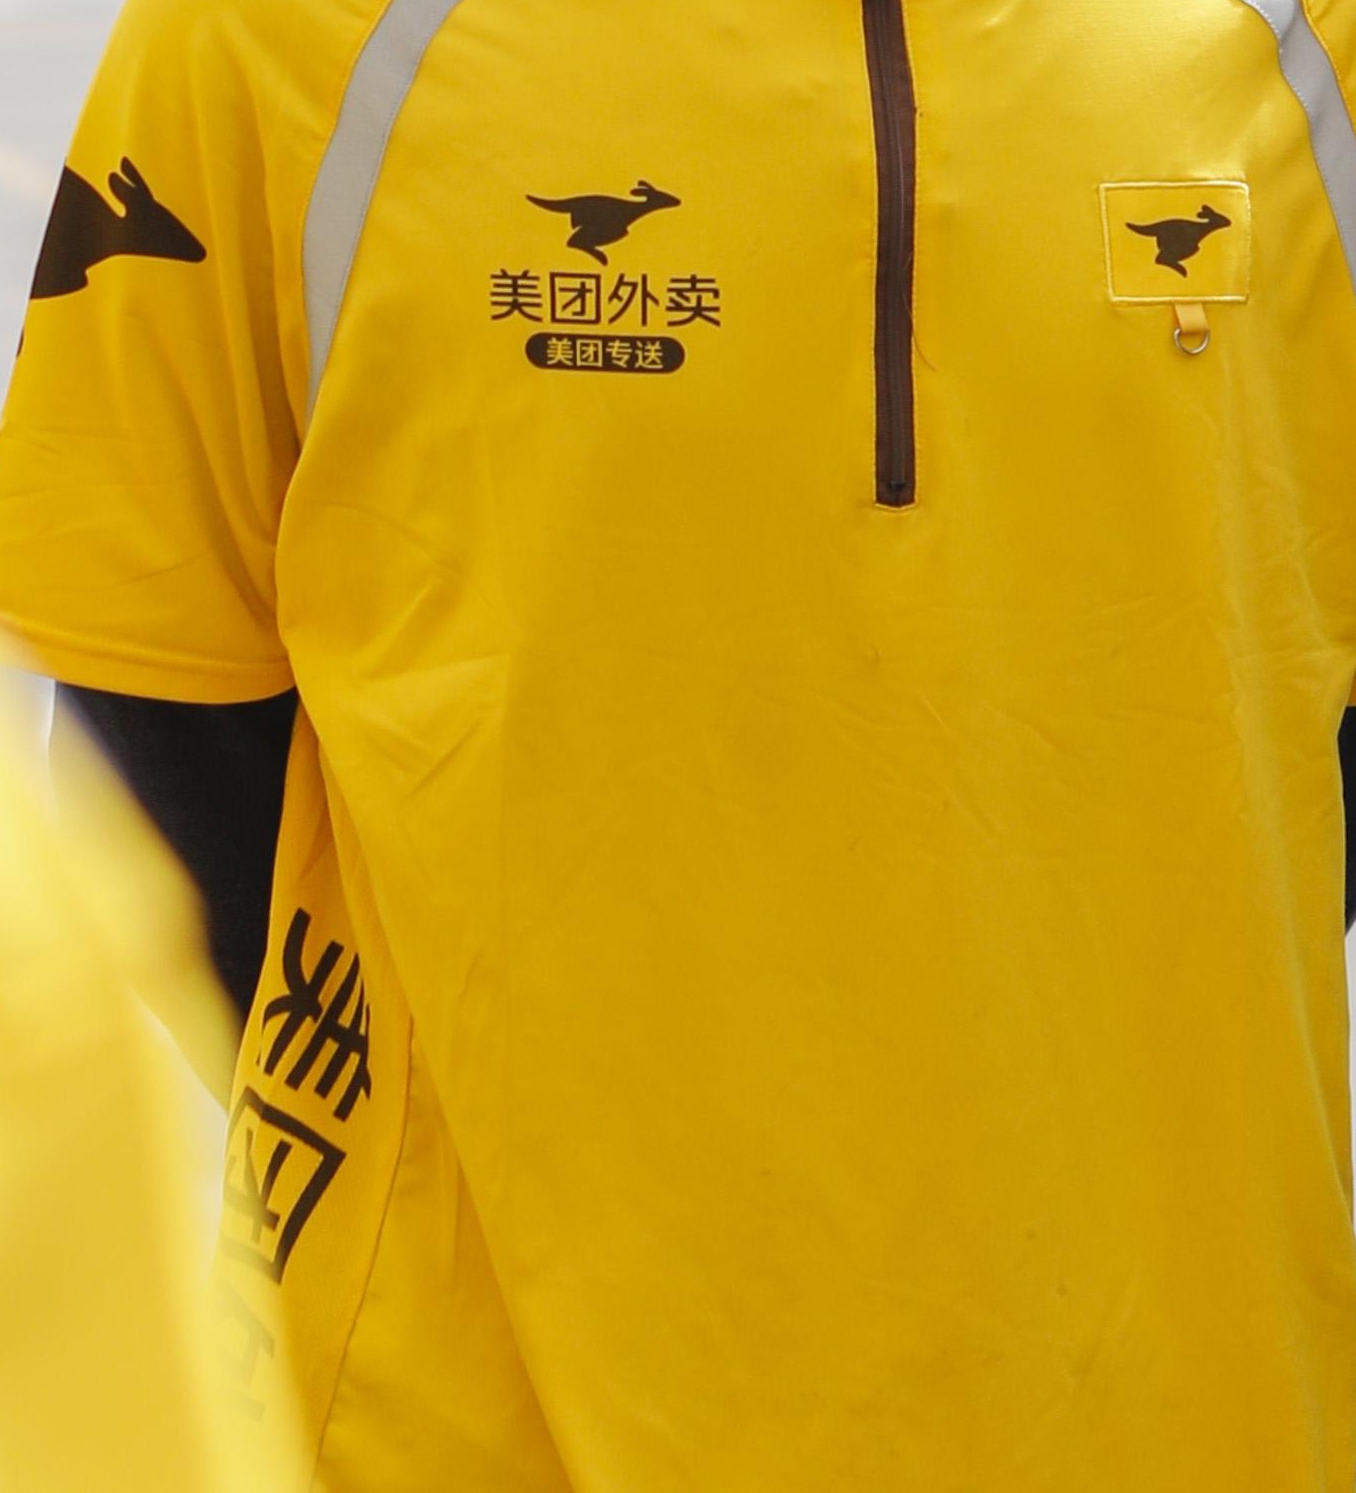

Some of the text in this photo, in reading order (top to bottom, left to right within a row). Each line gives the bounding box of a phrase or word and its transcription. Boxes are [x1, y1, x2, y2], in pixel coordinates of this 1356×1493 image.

[489, 268, 722, 328] 美团外卖
[545, 337, 665, 370] 美团专送
